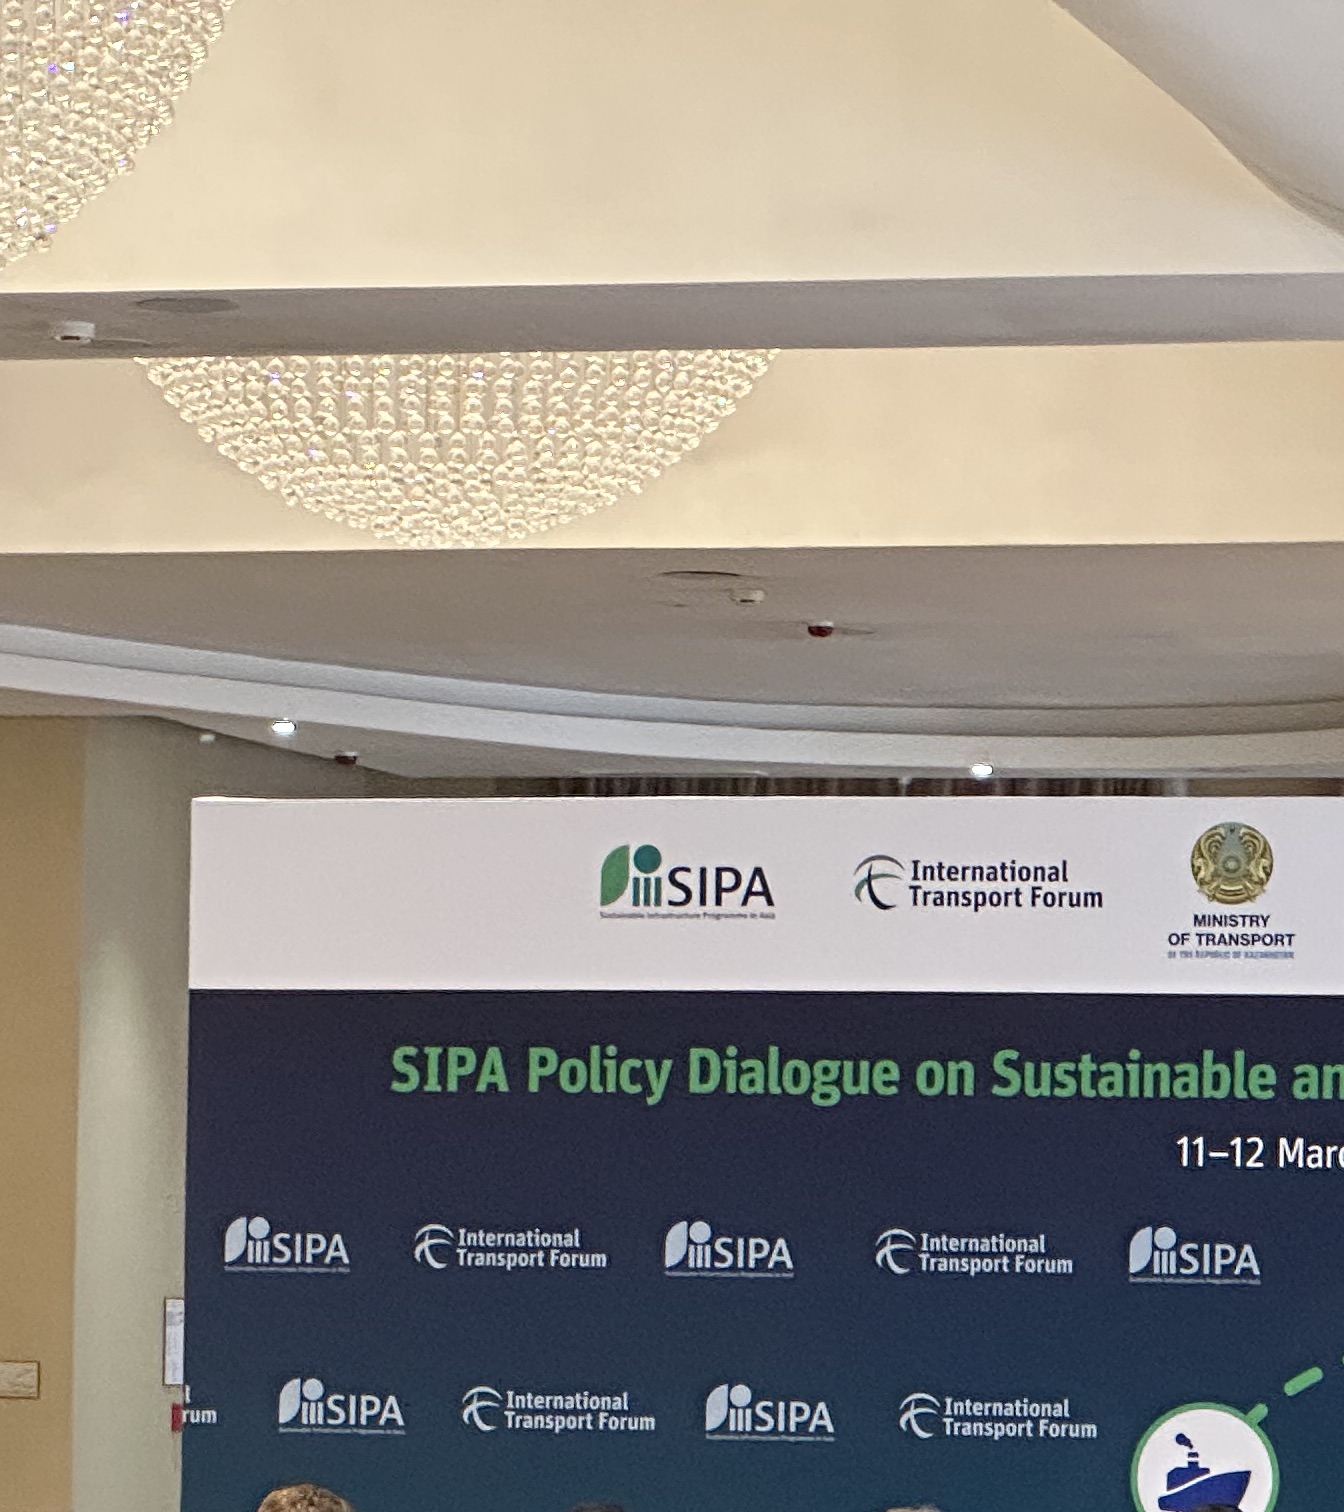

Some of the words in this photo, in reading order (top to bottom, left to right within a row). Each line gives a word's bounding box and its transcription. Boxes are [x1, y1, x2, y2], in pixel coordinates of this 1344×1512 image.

[912, 860, 1068, 882] International
[668, 867, 774, 906] SIPA
[909, 885, 1022, 912] Transport
[1032, 886, 1102, 907] Forum
[1194, 914, 1270, 927] MINISTRY
[1168, 933, 1190, 945] OF
[1196, 933, 1295, 946] TRANSPORT
[391, 1046, 509, 1092] SIPA
[528, 1045, 672, 1105] Policy
[689, 1046, 900, 1106] Dialogue
[916, 1060, 974, 1096] on
[992, 1049, 1276, 1099] Sustainable
[272, 1233, 349, 1264] SIPA
[457, 1228, 580, 1247] International
[919, 1233, 1045, 1253] International
[456, 1249, 545, 1270] Transport
[550, 1250, 606, 1267] Forum
[713, 1238, 793, 1270] SIPA
[919, 1254, 1010, 1276] Transport
[1016, 1254, 1072, 1273] Forum
[1180, 1243, 1260, 1275] SIPA
[324, 1395, 404, 1426] SIPA
[504, 1391, 628, 1410] International
[943, 1398, 1069, 1417] International
[504, 1412, 593, 1433] Transport
[599, 1412, 655, 1430] Forum
[754, 1401, 834, 1432] SIPA
[943, 1418, 1034, 1440] Transport
[1039, 1418, 1097, 1438] Forum
